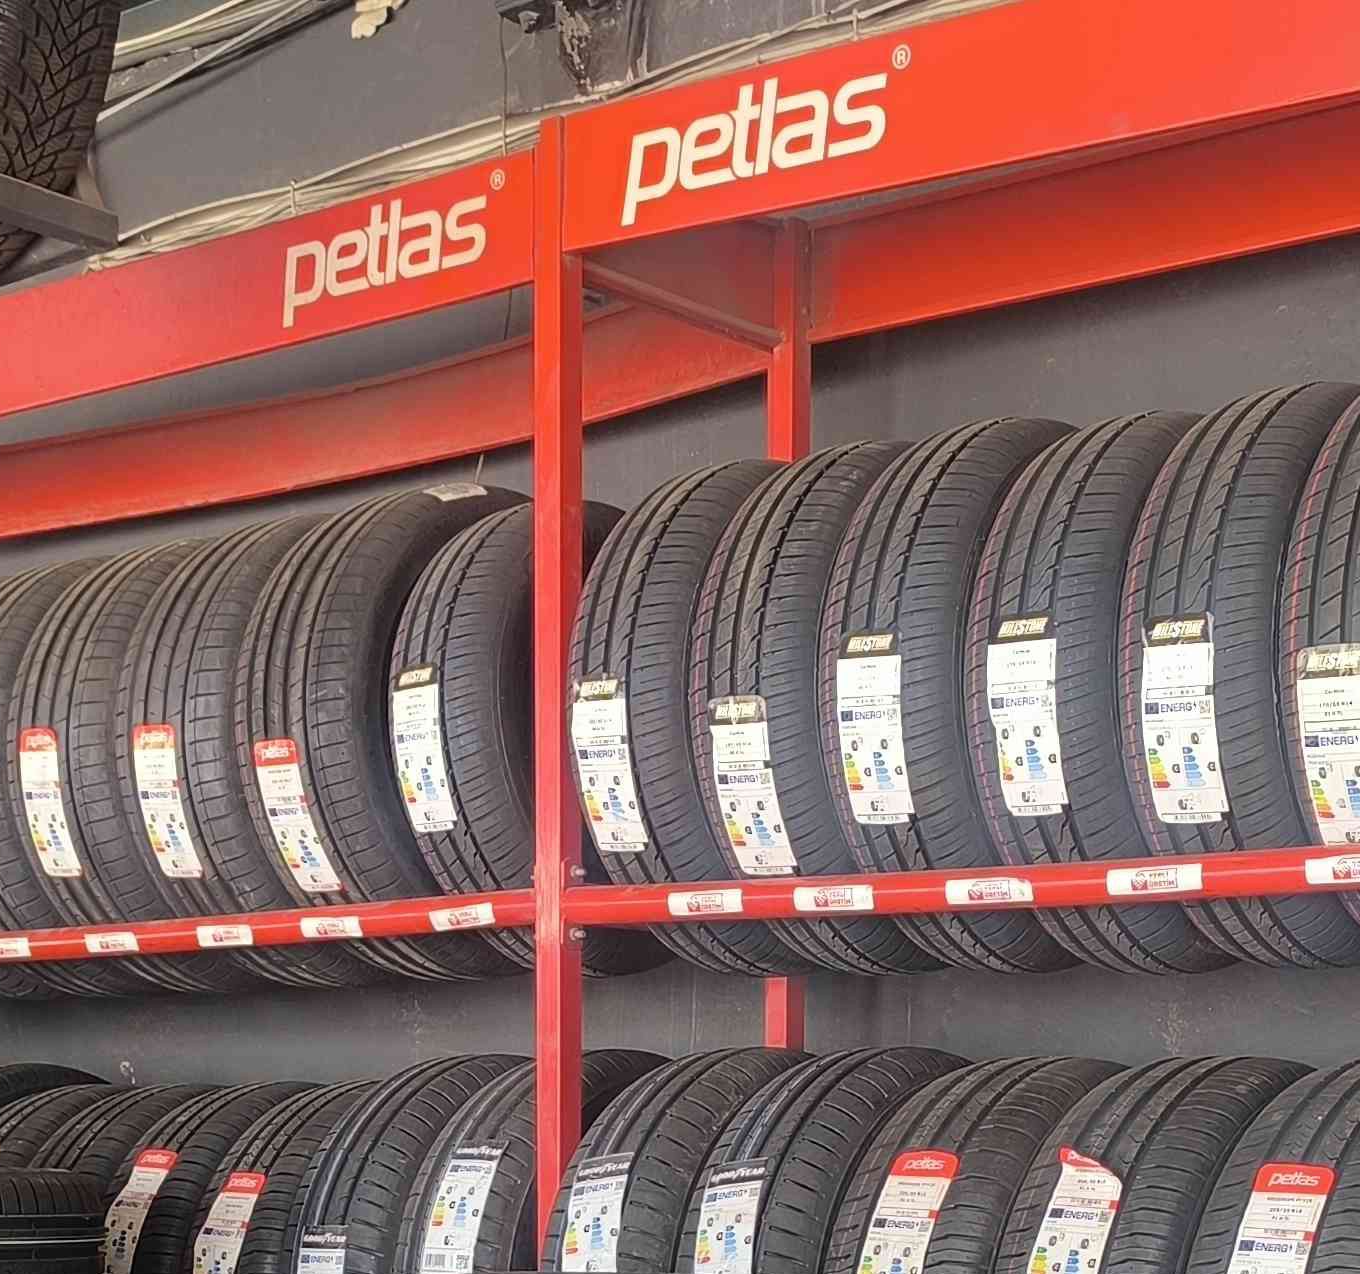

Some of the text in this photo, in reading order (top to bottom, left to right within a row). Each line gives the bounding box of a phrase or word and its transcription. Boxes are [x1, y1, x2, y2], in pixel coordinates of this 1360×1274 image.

[621, 73, 888, 227] petlas
[283, 194, 487, 328] petlas
[1005, 695, 1036, 708] ENERG
[1160, 702, 1193, 714] ENERG
[854, 711, 883, 721] ENERG
[1320, 736, 1355, 747] ENERG
[902, 1156, 945, 1171] petlas
[1268, 1171, 1320, 1187] petlas
[1063, 1210, 1094, 1221] ENERG
[887, 1220, 916, 1231] ENERG
[1255, 1240, 1289, 1254] ENERG
